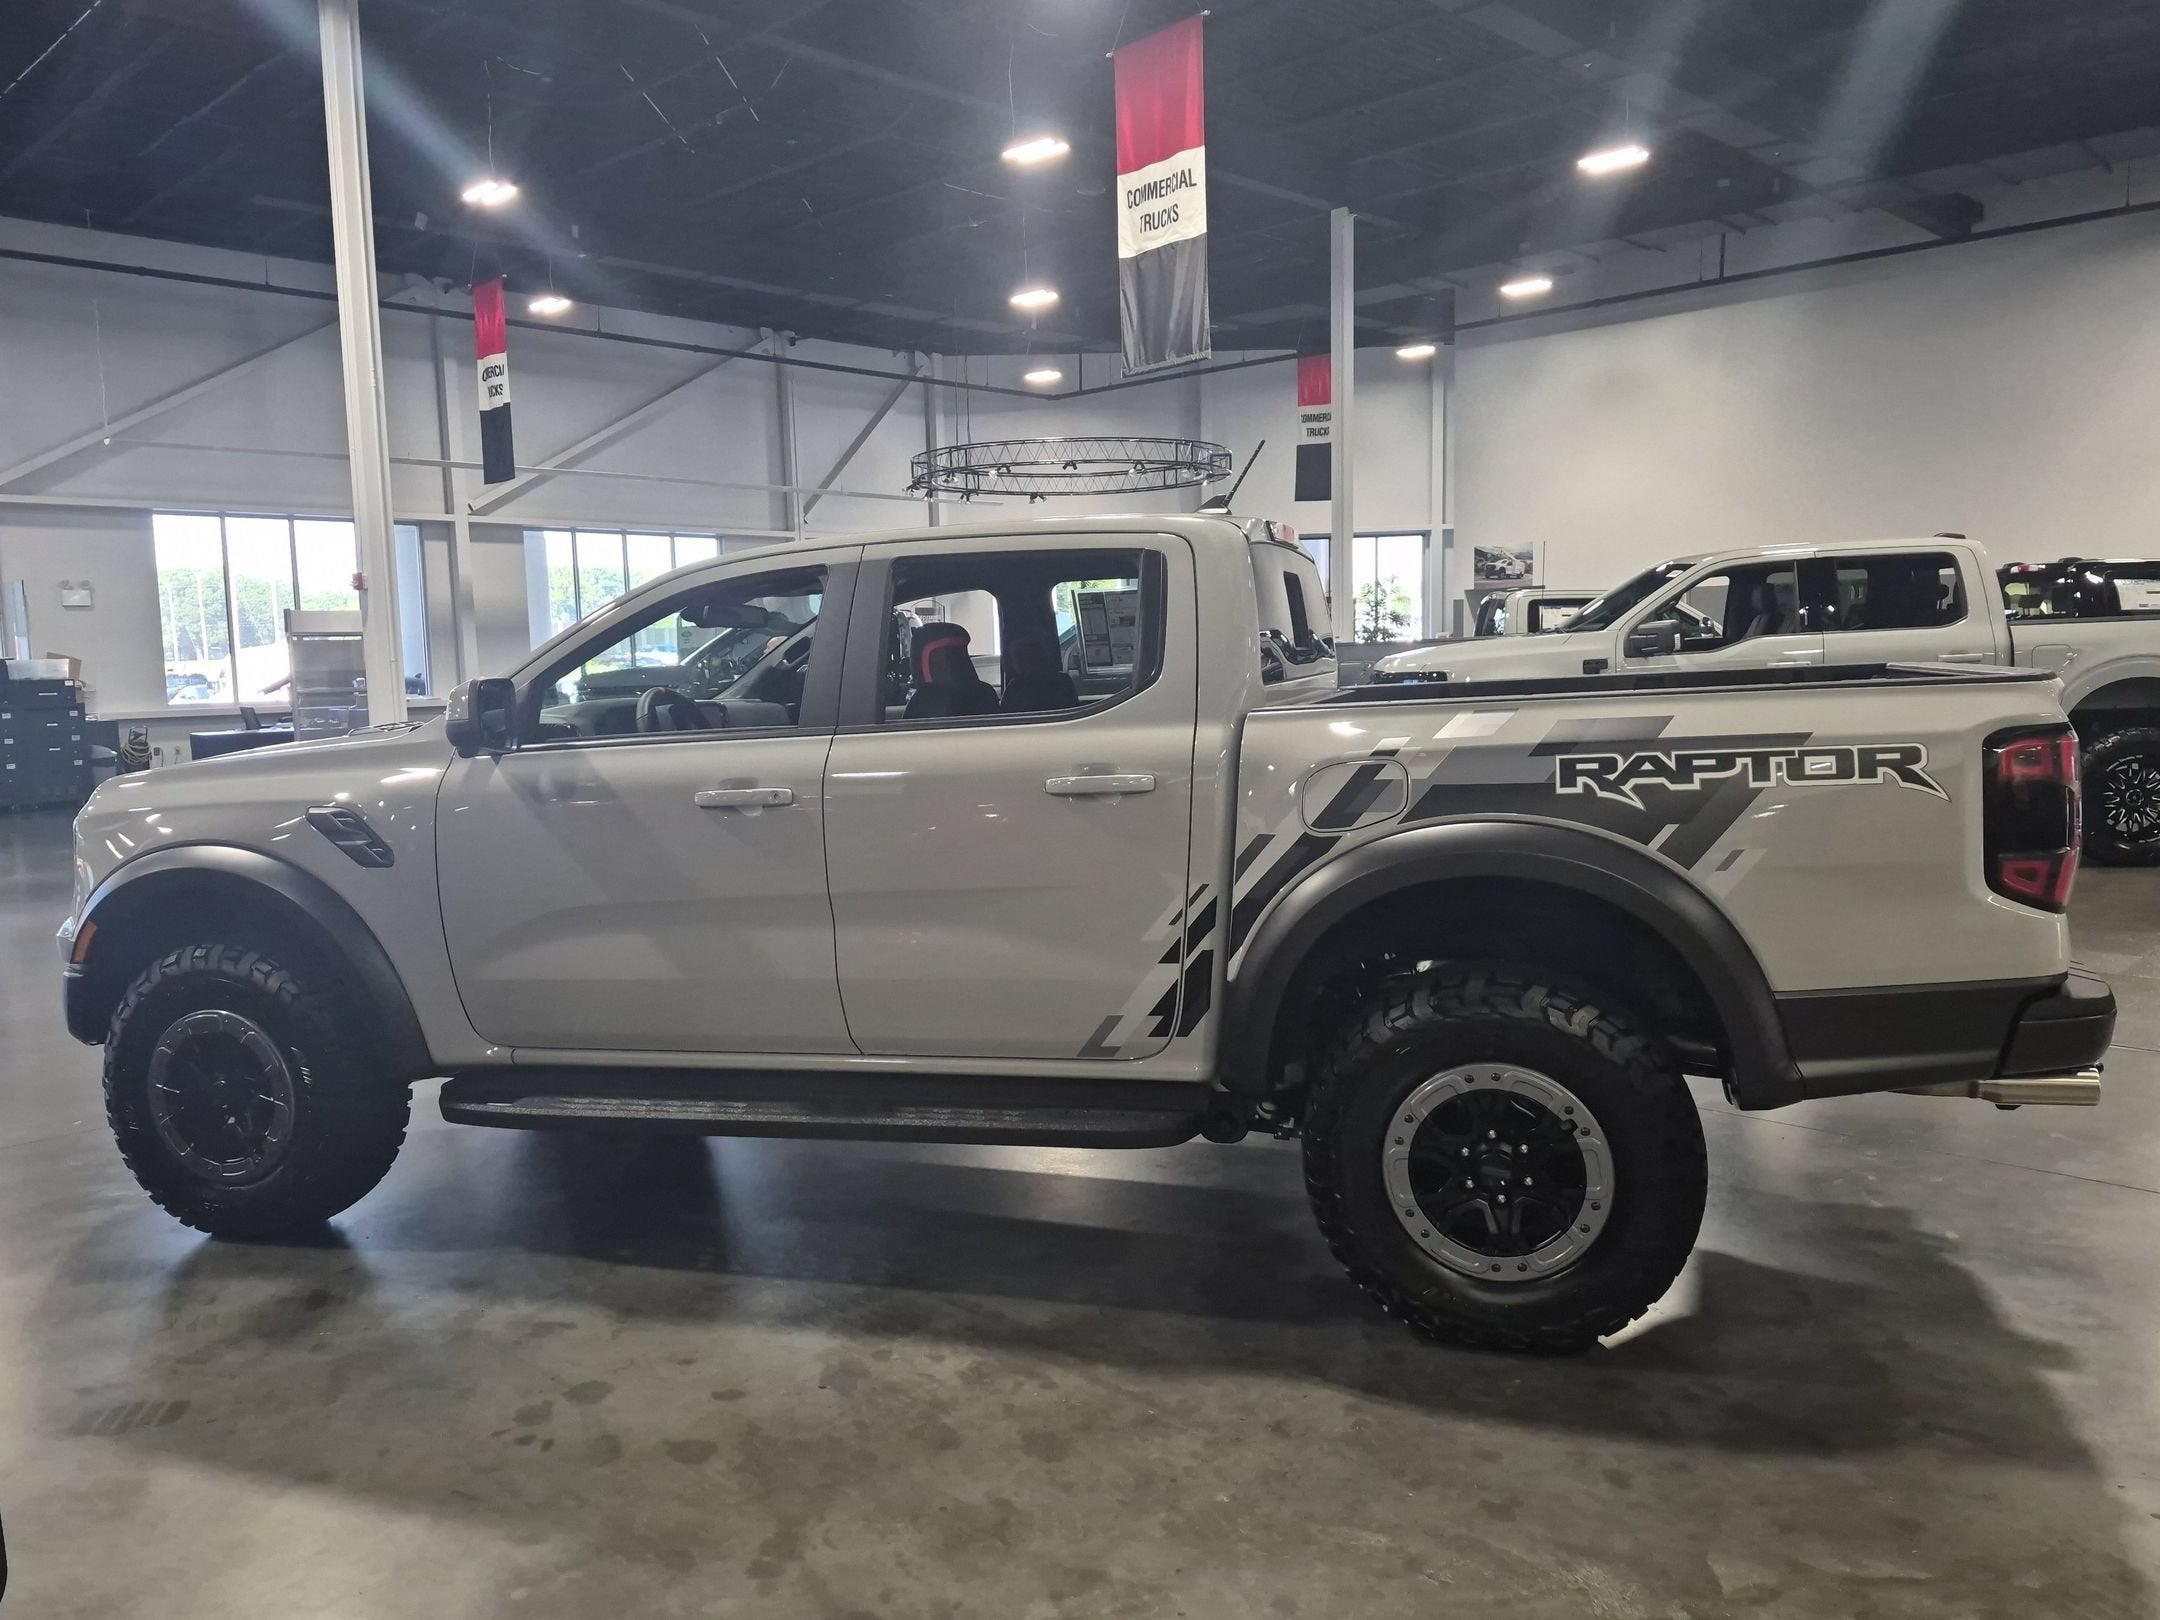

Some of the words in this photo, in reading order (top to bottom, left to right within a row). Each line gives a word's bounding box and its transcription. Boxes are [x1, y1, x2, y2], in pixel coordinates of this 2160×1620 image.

[1127, 168, 1197, 209] COMMERCIAL
[1140, 203, 1180, 234] TRUCKS
[1556, 743, 1951, 811] RAPTOR
